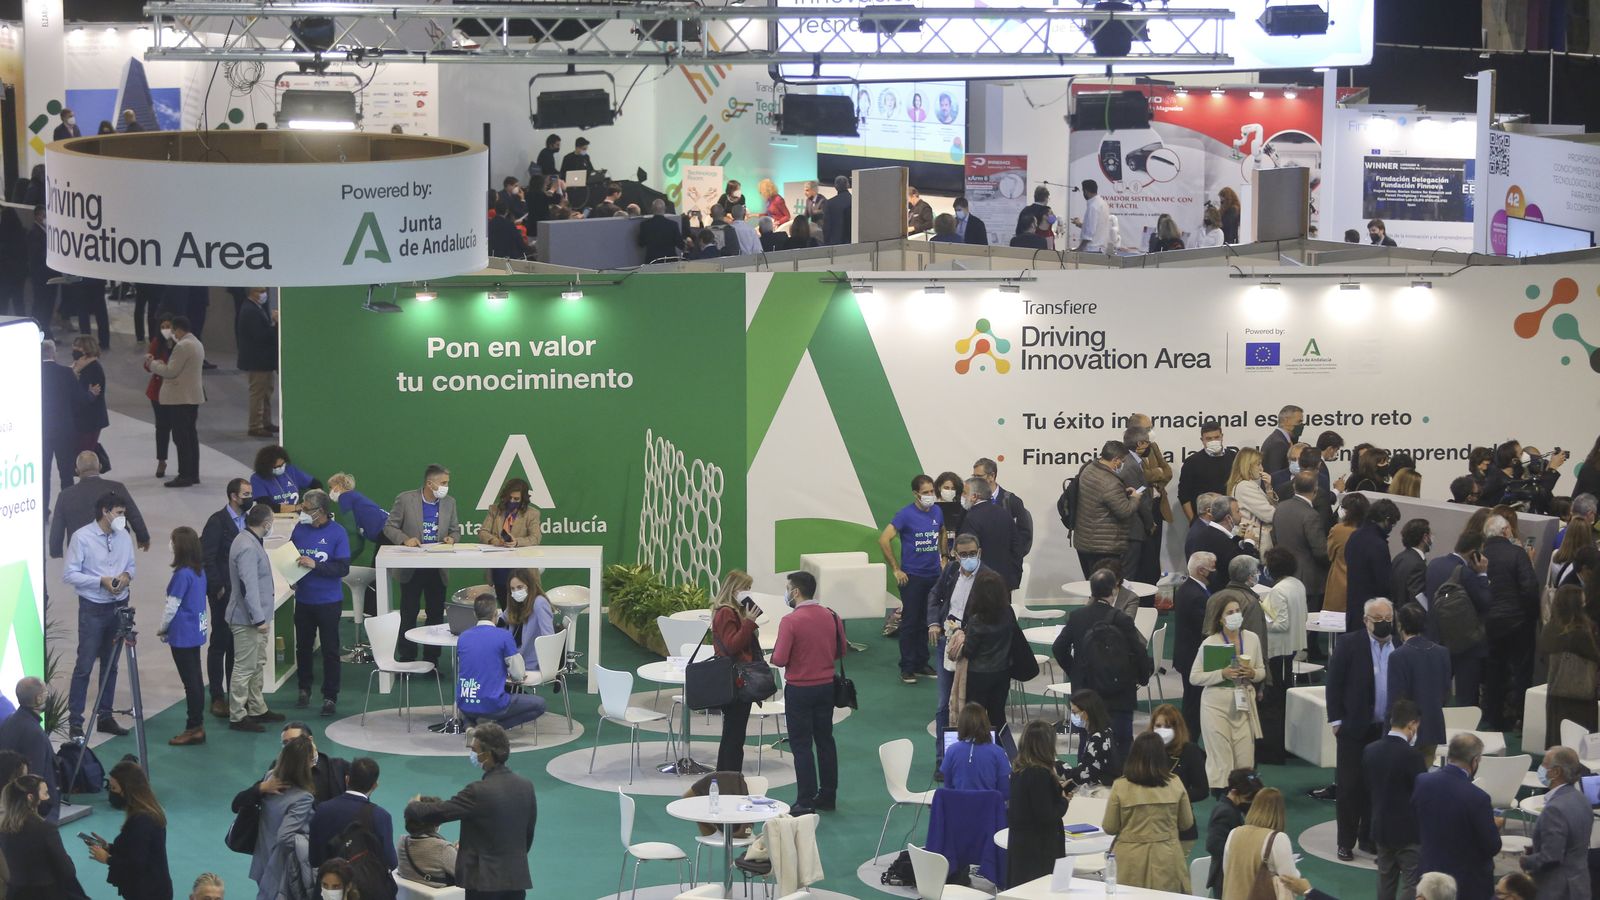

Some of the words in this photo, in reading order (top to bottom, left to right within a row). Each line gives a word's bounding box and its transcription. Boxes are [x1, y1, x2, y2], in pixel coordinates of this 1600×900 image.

[1364, 162, 1398, 170] WINNER
[1411, 176, 1449, 184] Delegación
[341, 182, 409, 200] Powered
[413, 181, 432, 199] by:
[1508, 193, 1519, 207] 42
[399, 215, 442, 233] Junta
[173, 231, 272, 270] Area
[399, 238, 419, 256] de
[422, 228, 477, 255] Andalucía
[1022, 300, 1097, 314] Transfiere
[1021, 325, 1106, 352] Driving
[1275, 328, 1285, 336] by:
[427, 337, 480, 358] Pon
[488, 340, 521, 357] en
[529, 335, 597, 357] valor
[1021, 348, 1148, 370] Innovation
[1154, 347, 1211, 369] Area
[396, 371, 424, 392] tu
[432, 368, 634, 391] conociminento
[1023, 412, 1047, 430] Tu
[1053, 411, 1105, 429] éxito
[1255, 414, 1278, 427] es
[1370, 410, 1412, 426] reto
[460, 678, 477, 688] Talk
[461, 687, 477, 698] ME
